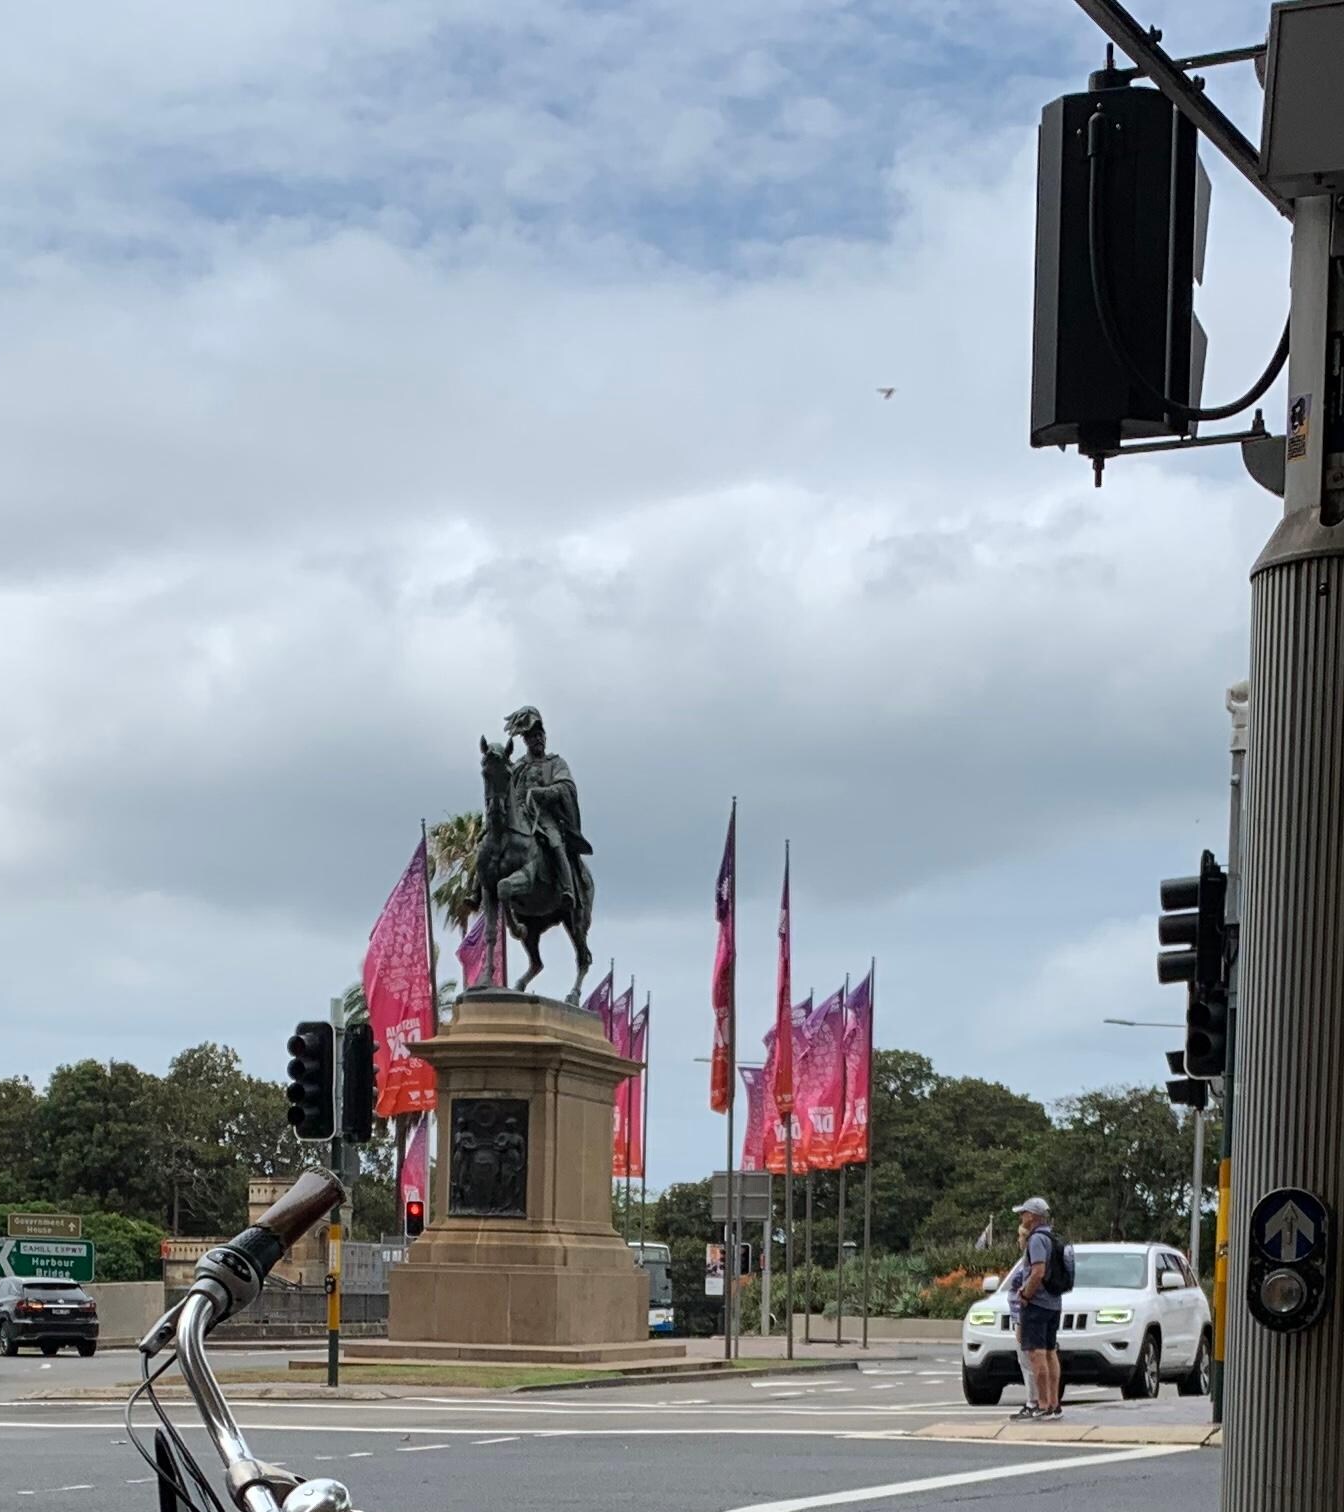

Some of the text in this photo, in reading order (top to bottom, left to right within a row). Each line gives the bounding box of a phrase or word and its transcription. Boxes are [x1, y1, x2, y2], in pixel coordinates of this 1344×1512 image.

[14, 1217, 65, 1227] Government
[26, 1226, 53, 1234] House
[22, 1245, 52, 1253] CAHILL
[31, 1257, 75, 1267] Harbour
[36, 1268, 71, 1278] Bridge
